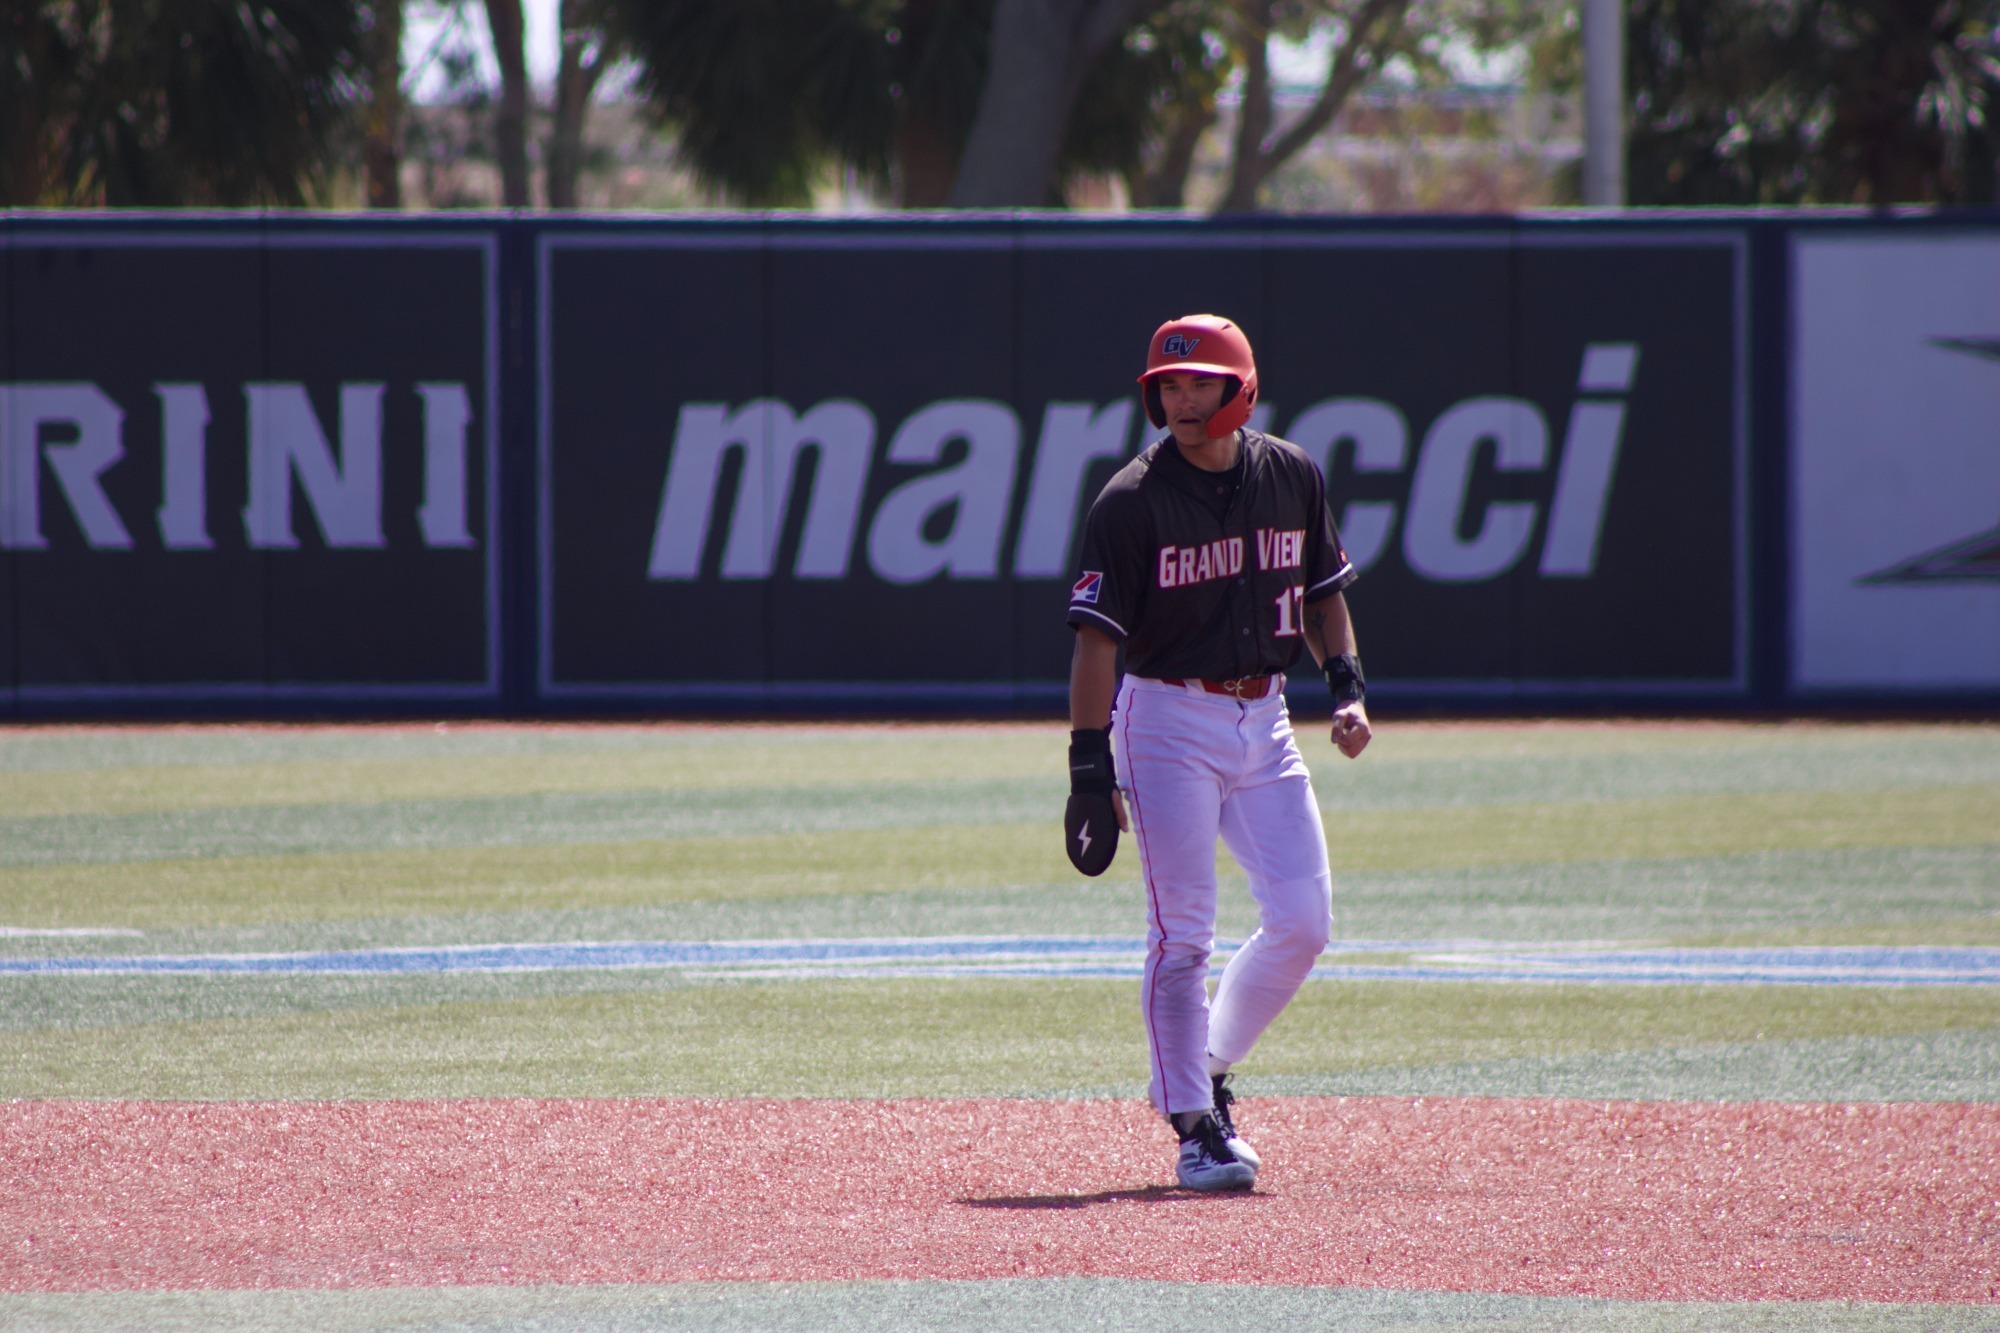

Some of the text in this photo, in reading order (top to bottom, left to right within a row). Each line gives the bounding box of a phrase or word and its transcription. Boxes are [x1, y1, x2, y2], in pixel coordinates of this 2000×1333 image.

[1162, 334, 1200, 358] GV
[0, 382, 476, 549] RINI
[648, 343, 1640, 584] marcci
[1159, 527, 1306, 588] GRAND VIEW
